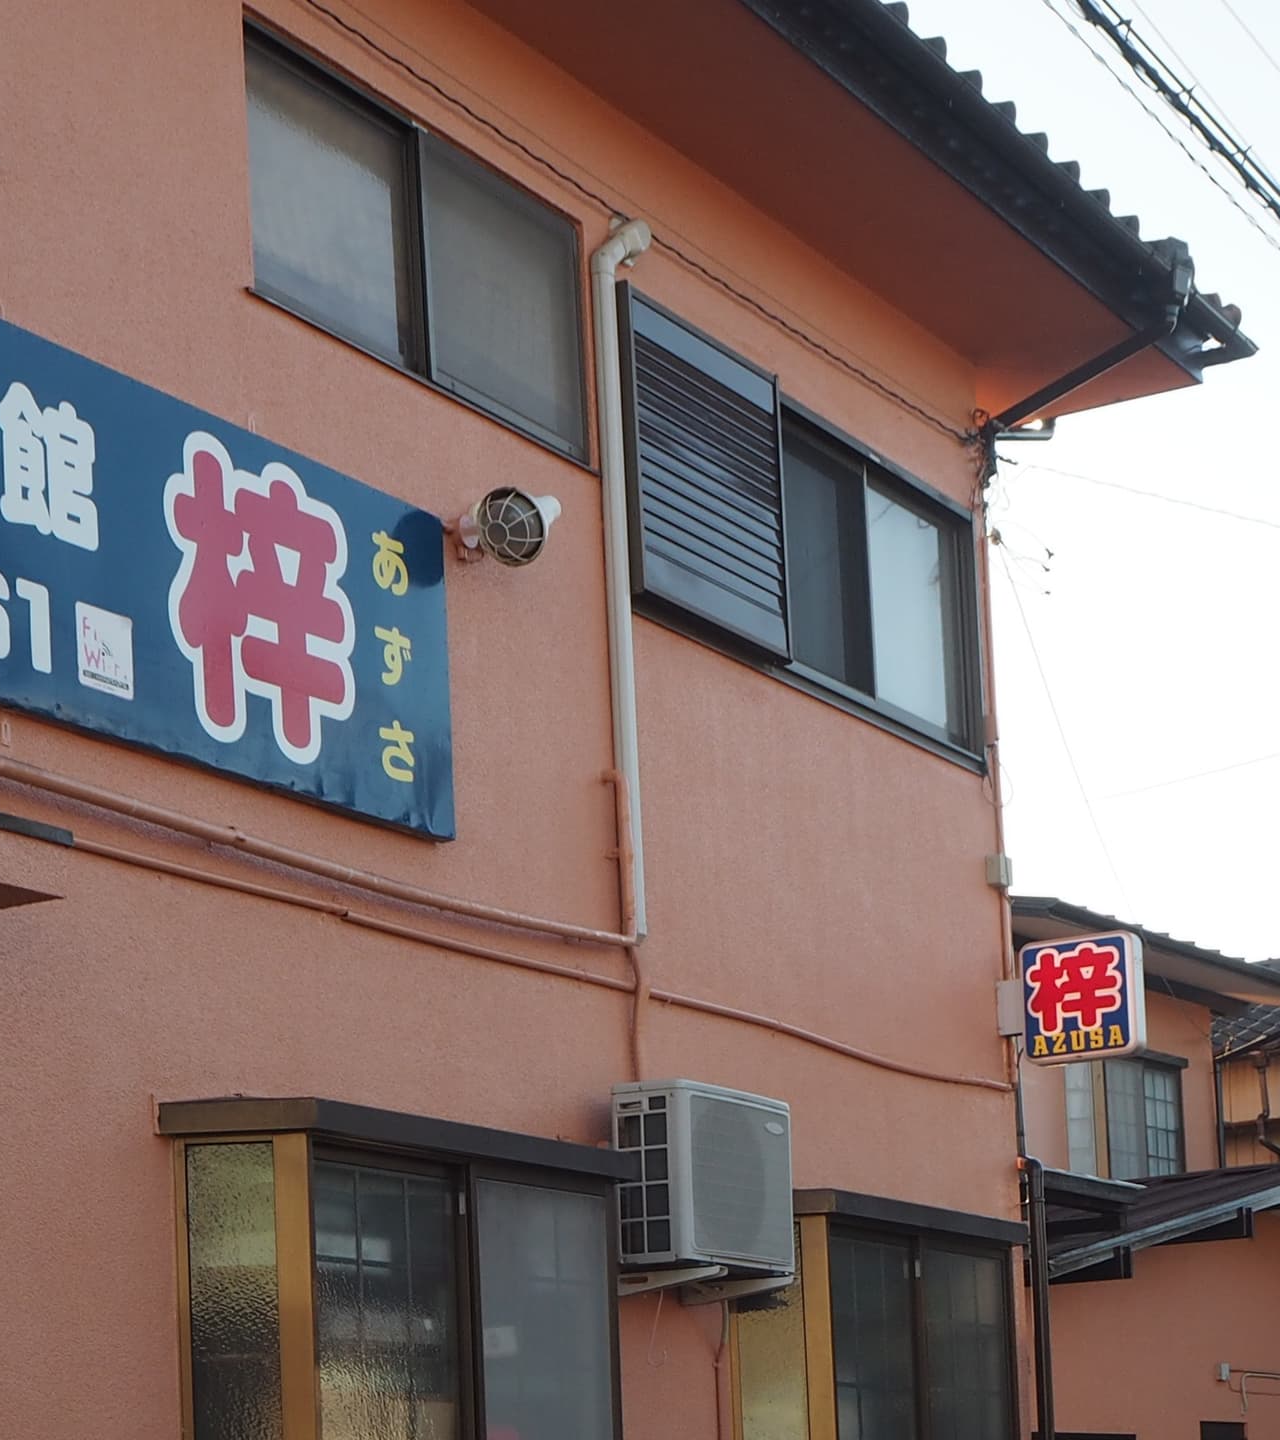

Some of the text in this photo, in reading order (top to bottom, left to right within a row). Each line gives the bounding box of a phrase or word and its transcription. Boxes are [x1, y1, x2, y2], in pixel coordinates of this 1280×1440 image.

[163, 430, 356, 765] 梓
[371, 529, 416, 783] あずさ
[1026, 942, 1123, 1036] 梓
[1032, 1024, 1124, 1057] AZUSA
